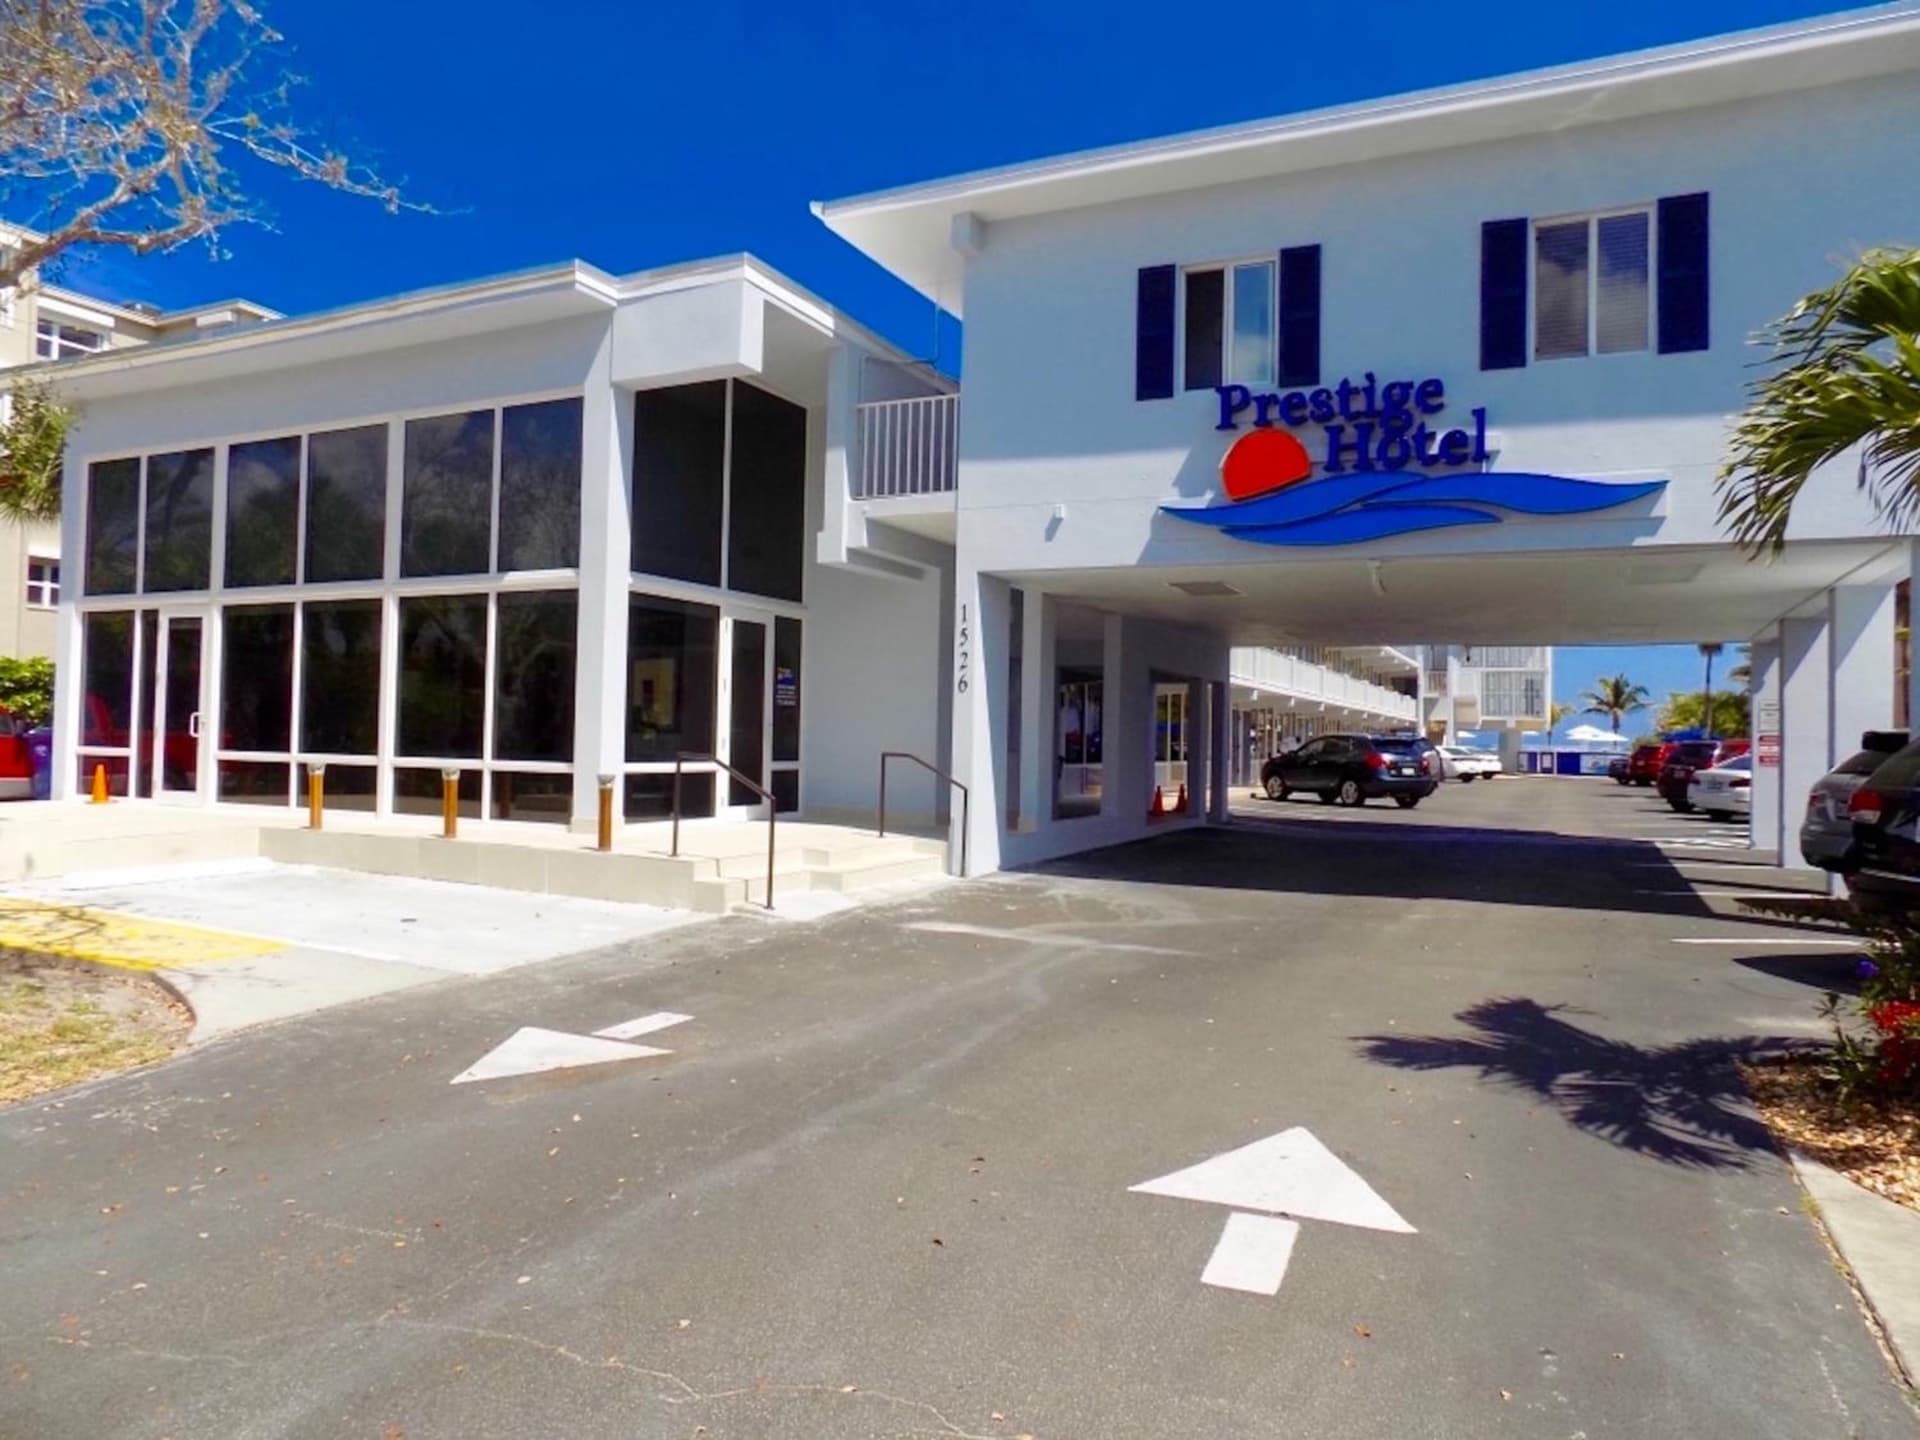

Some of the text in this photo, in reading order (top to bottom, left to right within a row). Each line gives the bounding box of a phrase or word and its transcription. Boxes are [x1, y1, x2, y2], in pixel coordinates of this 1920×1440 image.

[1215, 371, 1445, 430] Prestige
[1323, 406, 1491, 472] Hotel
[957, 603, 969, 694] 1526
